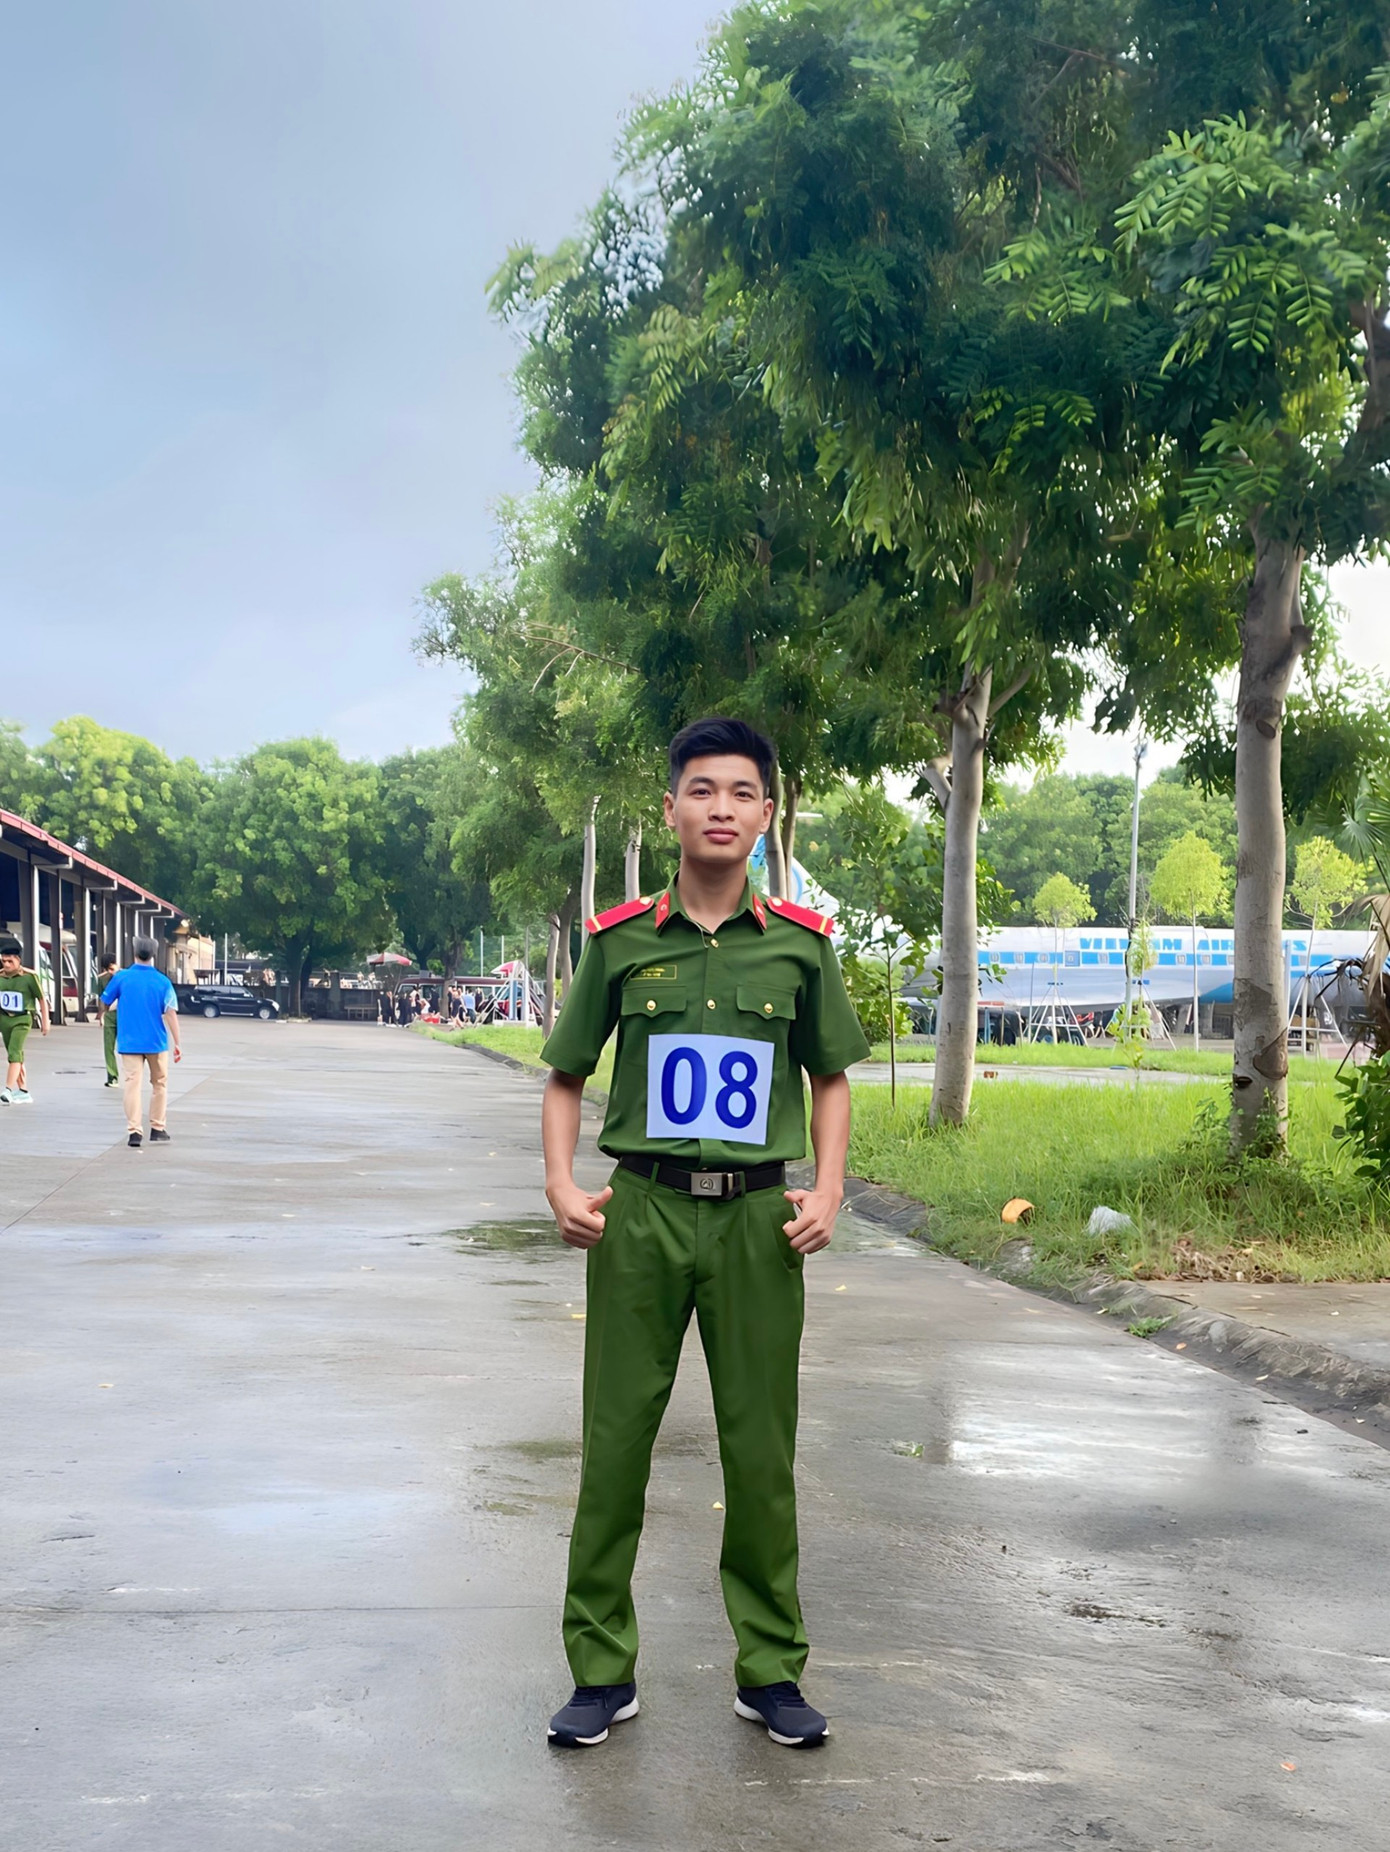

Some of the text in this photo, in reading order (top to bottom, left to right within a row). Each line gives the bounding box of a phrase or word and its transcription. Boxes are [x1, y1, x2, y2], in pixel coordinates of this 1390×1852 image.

[1197, 938, 1307, 951] AIRS
[2, 993, 18, 1008] 01
[661, 1046, 758, 1129] 08
